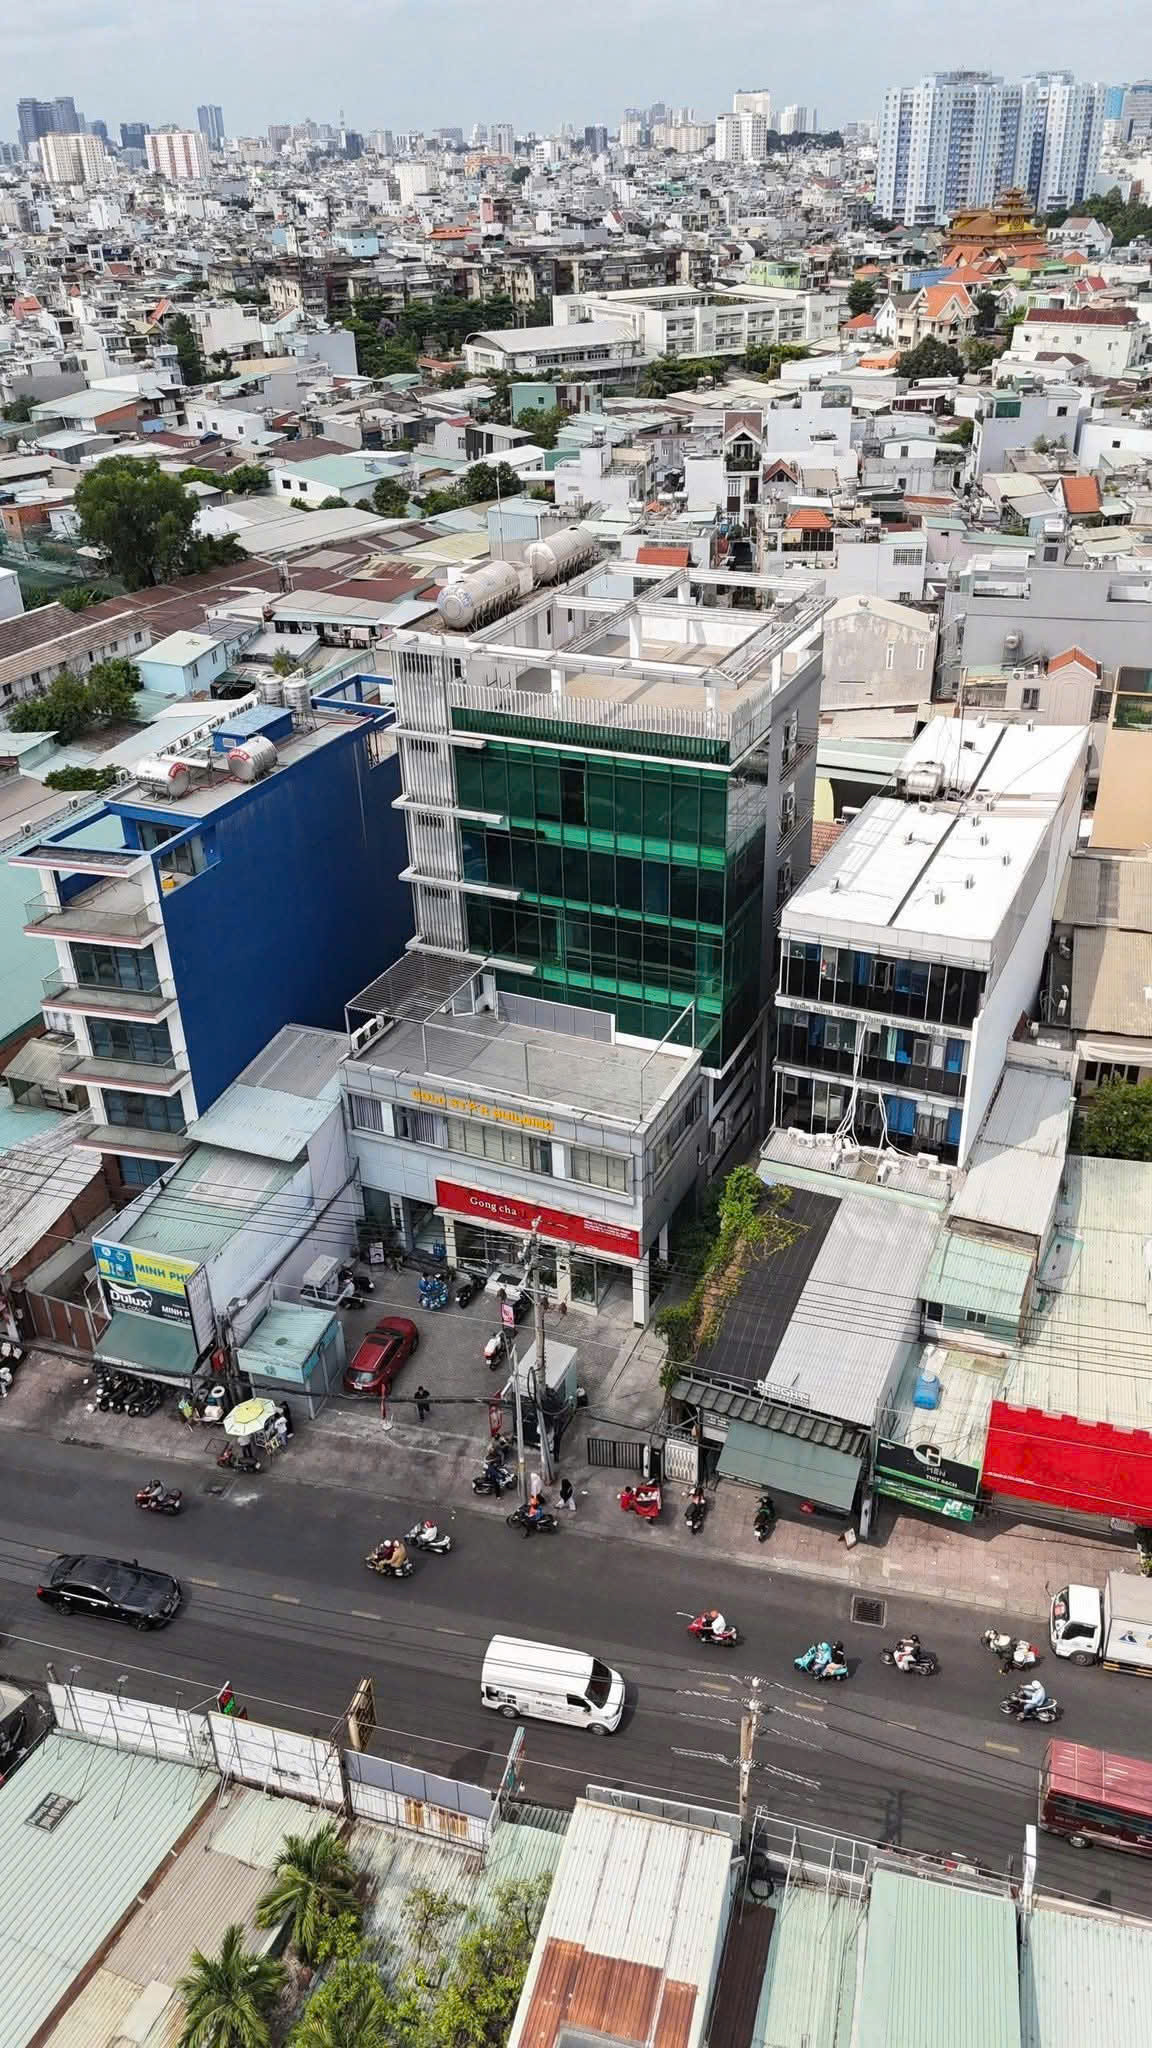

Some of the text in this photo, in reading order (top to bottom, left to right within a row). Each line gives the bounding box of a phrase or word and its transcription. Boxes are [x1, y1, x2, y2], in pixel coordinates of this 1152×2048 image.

[494, 1106, 554, 1131] BUILDING
[470, 1196, 517, 1216] Gong cha
[135, 1263, 166, 1278] MINH
[109, 1289, 149, 1308] Dulux
[161, 1305, 183, 1317] MINH
